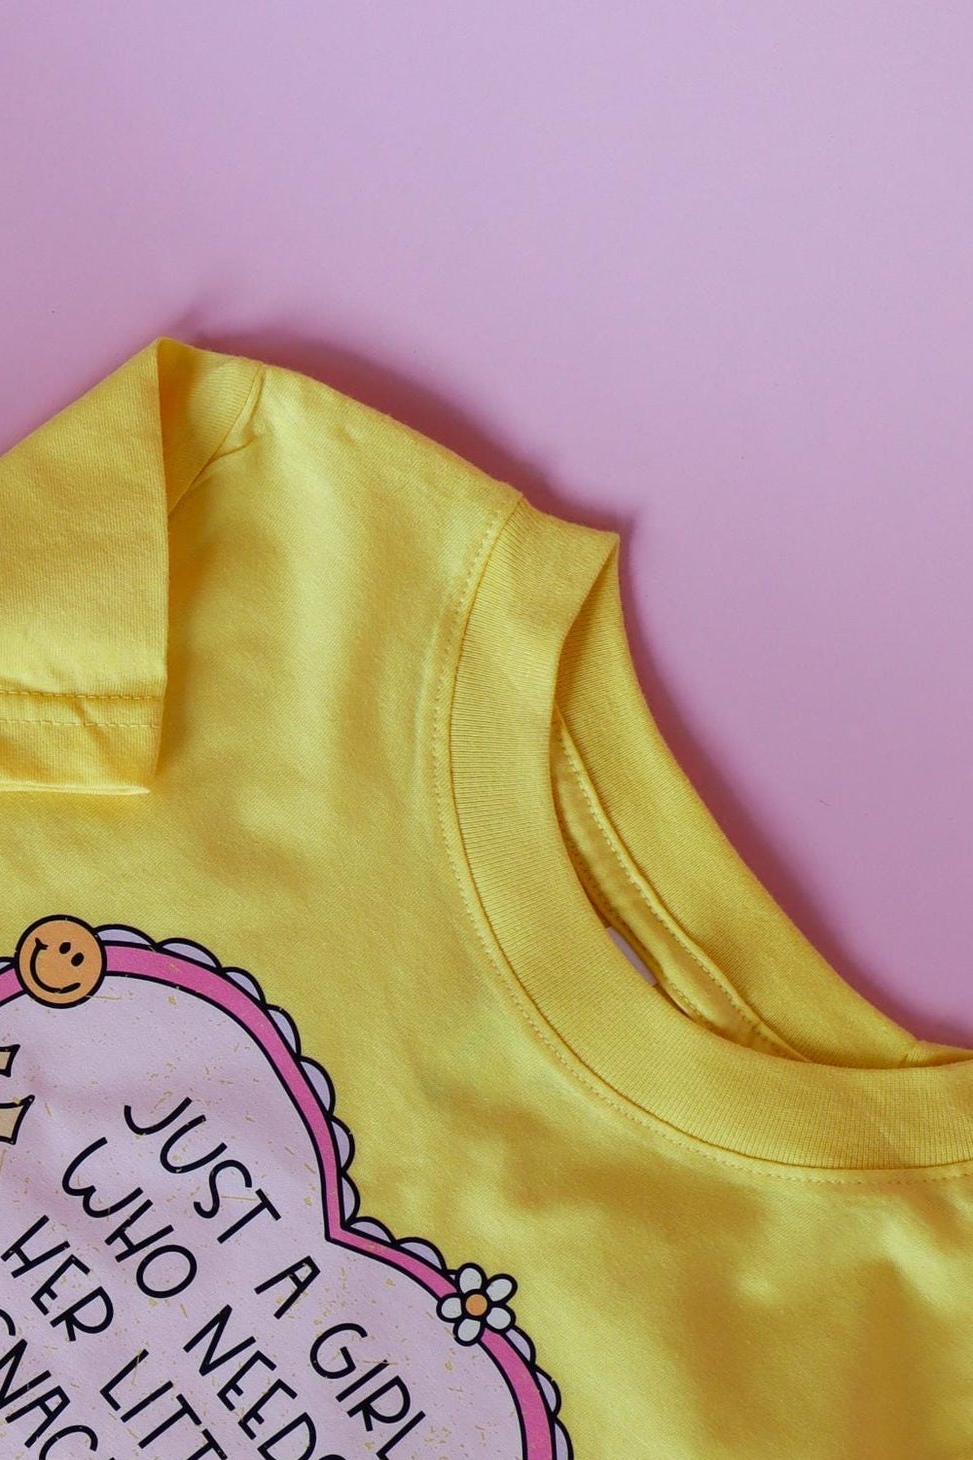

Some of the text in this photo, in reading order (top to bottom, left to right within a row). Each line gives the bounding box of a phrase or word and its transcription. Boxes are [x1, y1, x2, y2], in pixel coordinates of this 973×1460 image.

[0, 1214, 115, 1342] HER
[61, 1136, 198, 1299] WHO
[123, 1096, 282, 1245] JUST
[253, 1255, 321, 1320] A
